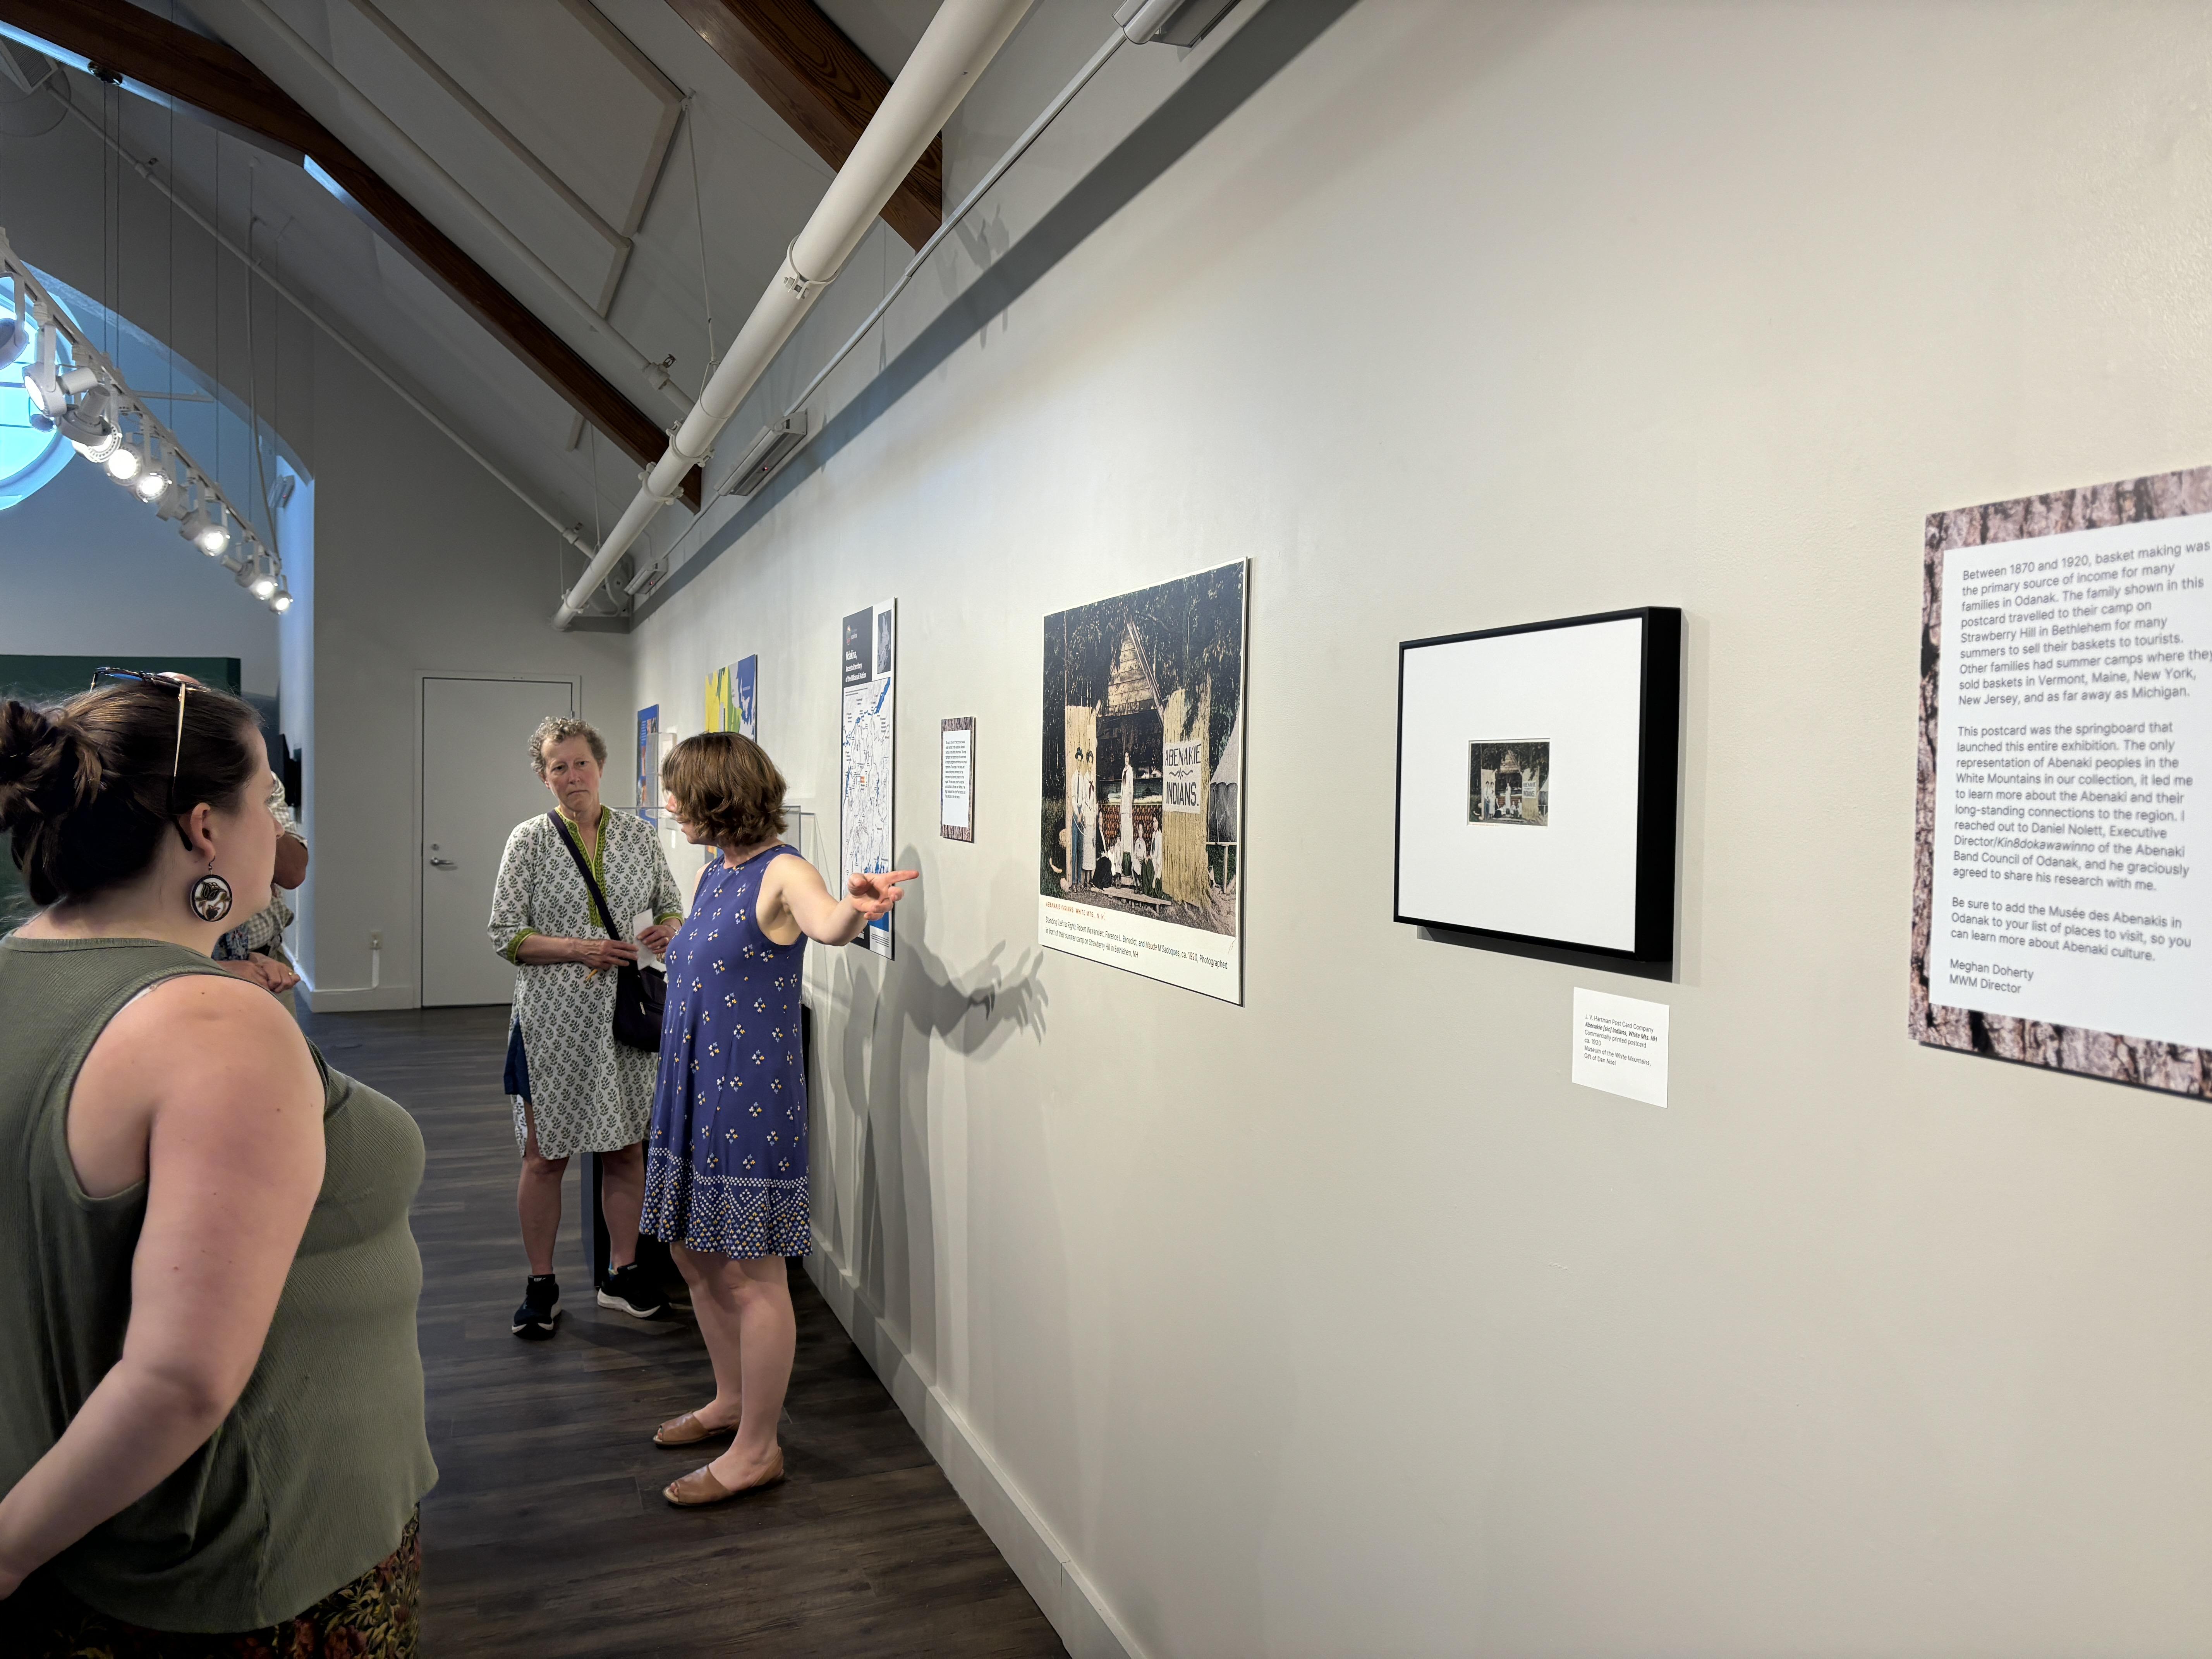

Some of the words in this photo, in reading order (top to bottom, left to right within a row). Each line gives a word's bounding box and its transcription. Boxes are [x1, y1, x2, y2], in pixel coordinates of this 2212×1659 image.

[1963, 568, 2006, 580] Between
[2010, 562, 2035, 574] 1870
[2038, 559, 2058, 571] and
[2062, 554, 2091, 567] 1920,
[2095, 550, 2135, 564] basket
[2138, 544, 2181, 558] making
[2185, 542, 2209, 553] was
[1961, 599, 2000, 611] families
[2003, 598, 2011, 607] in
[2015, 592, 2059, 606] Odanak.
[2063, 590, 2083, 601] The
[2087, 586, 2121, 599] family
[2124, 583, 2163, 595] shown
[2167, 580, 2178, 591] in
[2181, 576, 2204, 589] this
[1961, 613, 2006, 630] postcard
[2008, 609, 2054, 623] travelled
[2058, 608, 2069, 618] to
[2072, 605, 2098, 617] their
[2101, 603, 2133, 615] camp
[2136, 602, 2151, 611] on
[1961, 631, 2016, 643] Strawberry
[2020, 627, 2036, 638] Hill
[2039, 626, 2048, 636] in
[2052, 623, 2111, 635] Bethlehem
[2115, 620, 2131, 630] for
[2134, 617, 2167, 629] many
[1960, 648, 2006, 658] summers
[2009, 646, 2019, 655] to
[2022, 643, 2040, 654] sell
[2043, 641, 2068, 653] their
[2071, 639, 2116, 651] baskets
[2119, 638, 2131, 647] to
[2135, 633, 2183, 646] tourists.
[1959, 679, 1980, 690] sold
[1983, 678, 2023, 689] baskets
[2026, 676, 2035, 686] in
[2039, 674, 2088, 685] Vermont,
[2092, 672, 2130, 683] Maine,
[2134, 670, 2161, 680] New
[2165, 668, 2196, 681] York,
[1958, 726, 1978, 736] This
[1981, 725, 2027, 738] postcard
[2030, 726, 2051, 735] was
[2054, 724, 2073, 735] the
[2075, 722, 2145, 736] springboard
[2148, 721, 2173, 733] that
[1165, 744, 1201, 766] ABENAKIE
[1956, 757, 2030, 769] representation
[2033, 757, 2044, 768] of
[2047, 757, 2092, 768] Abenaki
[2095, 757, 2142, 769] peoples
[2145, 757, 2155, 768] in
[2159, 757, 2179, 768] the
[1166, 781, 1199, 806] INDIANS.
[1955, 789, 1965, 799] to
[1968, 789, 1993, 799] learn
[1996, 792, 2022, 800] more
[2025, 790, 2056, 800] about
[2059, 791, 2078, 801] the
[2080, 791, 2127, 802] Abenaki
[2130, 793, 2152, 803] and
[2156, 792, 2185, 804] their
[1954, 804, 2025, 818] long-standing
[2028, 807, 2095, 819] connections
[2098, 809, 2110, 819] to
[2113, 809, 2133, 820] the
[2135, 810, 2177, 823] region.
[2097, 842, 2110, 853] of
[2113, 843, 2133, 854] the
[2135, 844, 2185, 857] Abenaki
[1953, 850, 1978, 862] Band
[1981, 852, 2020, 864] Council
[2022, 855, 2033, 865] of
[2036, 855, 2081, 870] Odanak,
[2084, 860, 2106, 870] and
[2109, 860, 2124, 871] he
[2127, 863, 2190, 878] graciously
[1952, 897, 1965, 907] Be
[1967, 900, 1989, 910] sure
[1992, 901, 2002, 911] to
[2005, 903, 2025, 913] add
[2028, 904, 2045, 915] the
[2049, 905, 2086, 919] Musée
[2088, 910, 2110, 921] des
[2112, 912, 2167, 927] Abenakis
[2171, 917, 2181, 929] in
[1146, 941, 1157, 951] Maude
[1188, 952, 1199, 963] 1920,
[1200, 954, 1228, 969] Photographed
[1950, 930, 1968, 939] can
[1971, 930, 1996, 942] learn
[1999, 935, 2025, 946] more
[2028, 938, 2059, 950] about
[2062, 941, 2108, 955] Abenaki
[2111, 948, 2155, 961] culture.
[1950, 958, 1989, 973] Meghan
[1993, 964, 2034, 981] Doherty
[1949, 974, 1977, 987] MWM
[1980, 979, 2021, 993] Director
[1594, 1015, 1611, 1024] Hartman
[1633, 1024, 1654, 1034] Company
[1603, 1025, 1612, 1033] [sic]
[1613, 1027, 1627, 1037] Indians,
[1585, 1029, 1611, 1041] Commercially
[1628, 1040, 1646, 1048] postcard
[1584, 1045, 1601, 1053] Museum
[1628, 1055, 1651, 1067] Mountains,
